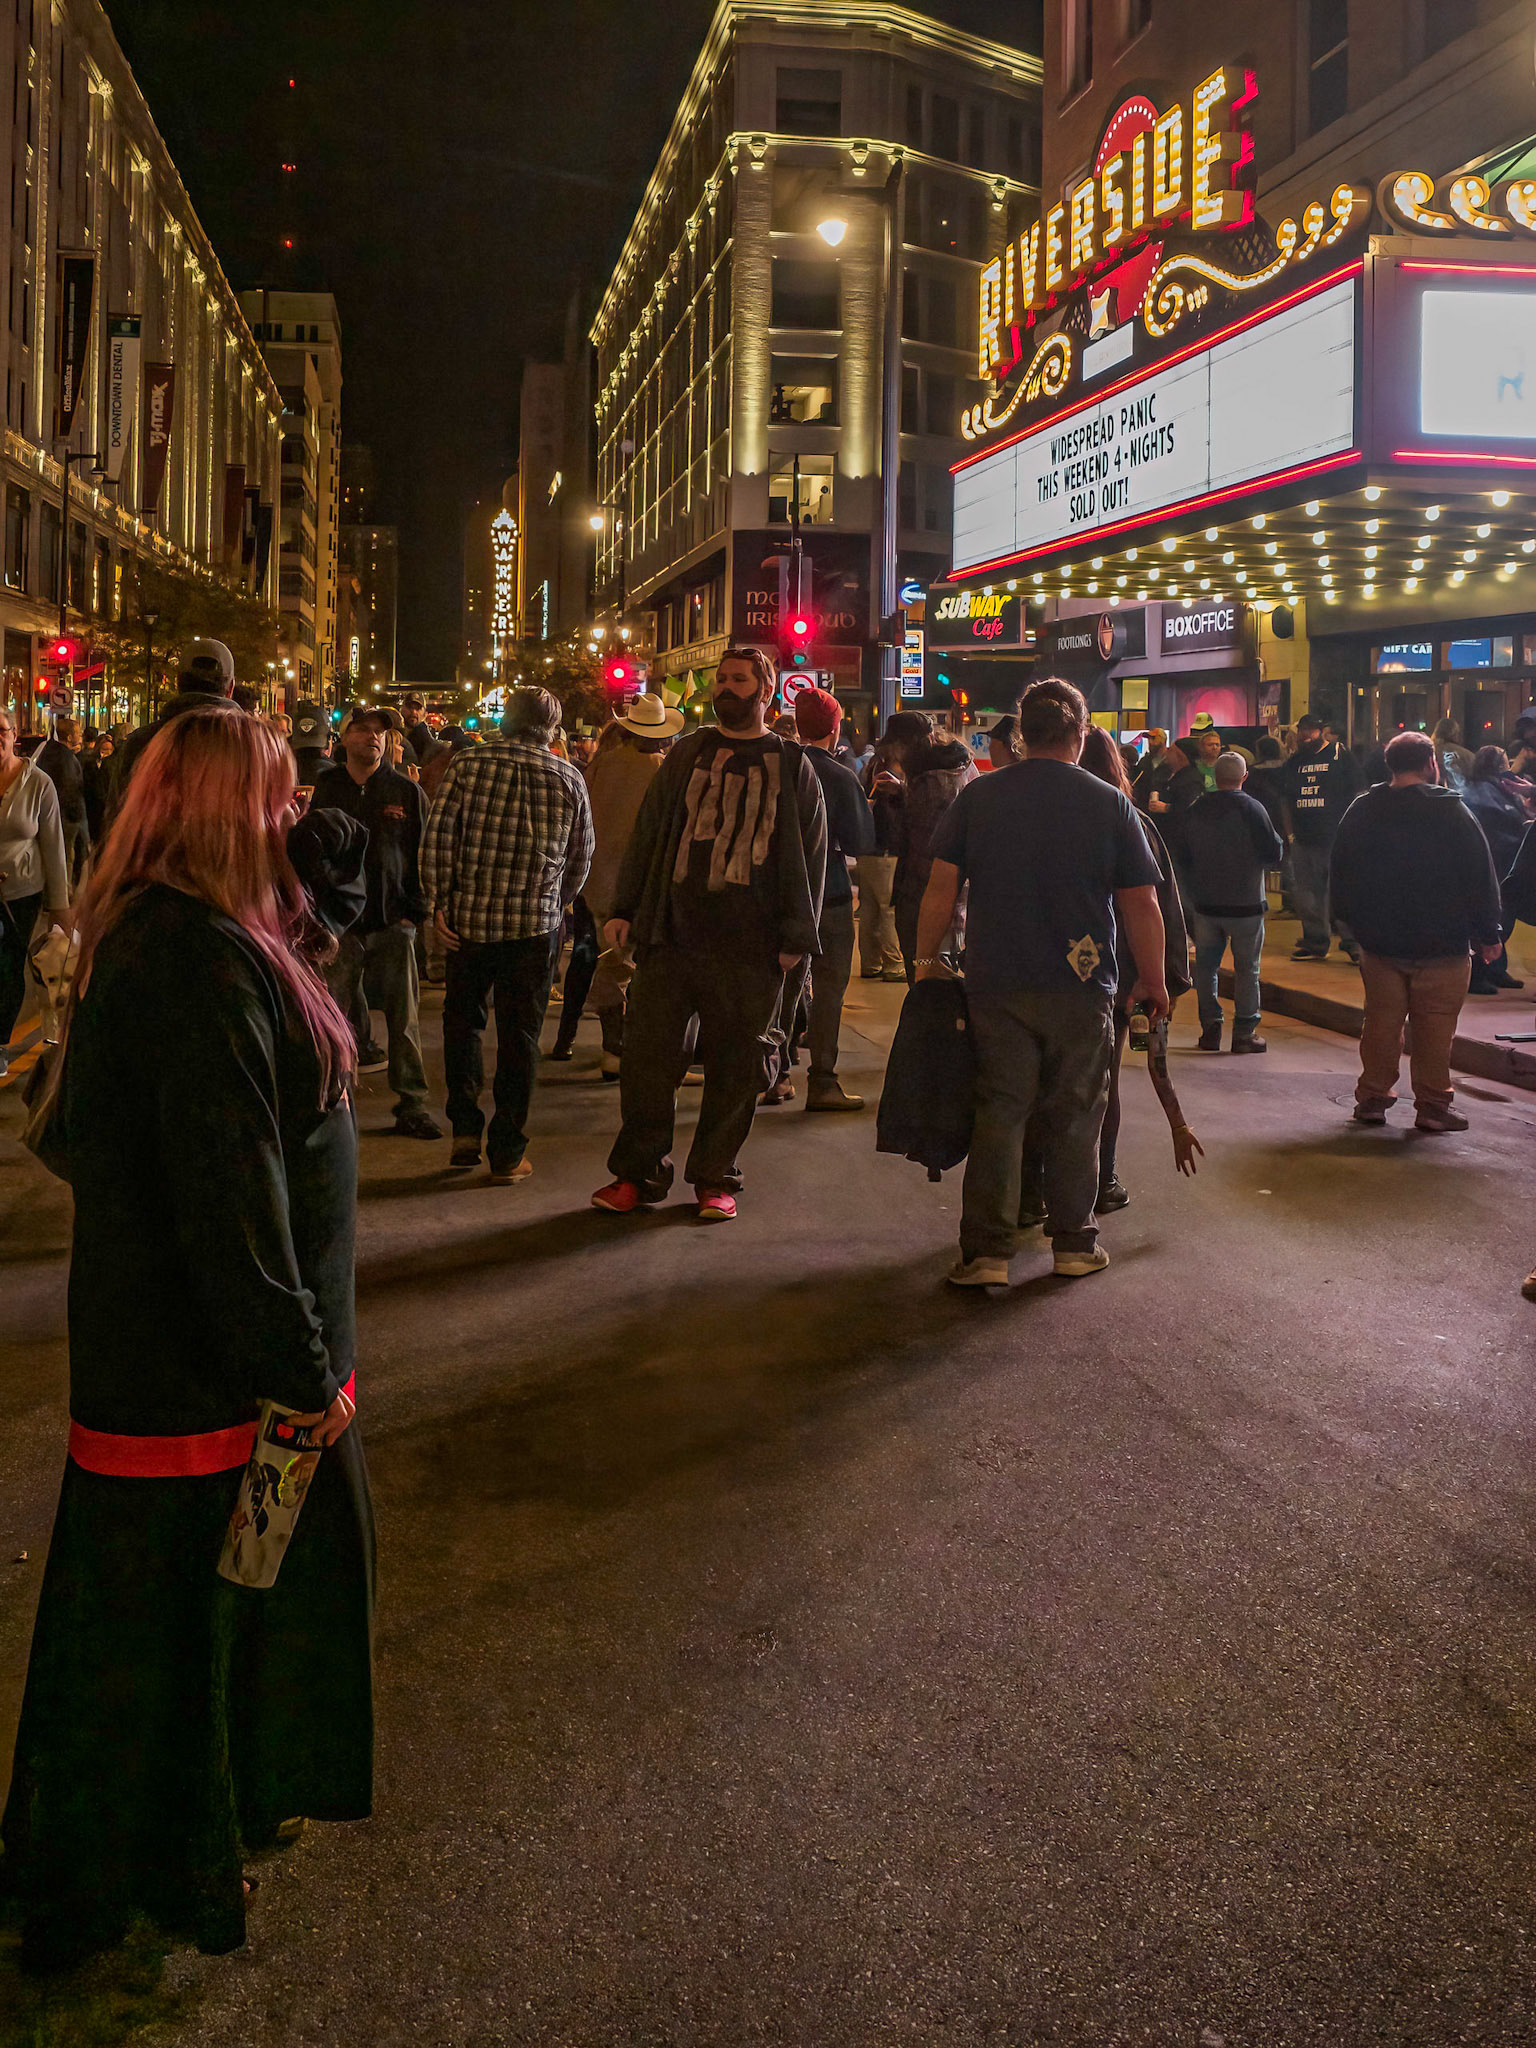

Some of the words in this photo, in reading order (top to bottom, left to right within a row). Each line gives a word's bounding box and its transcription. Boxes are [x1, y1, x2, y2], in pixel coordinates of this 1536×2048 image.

[979, 66, 1228, 380] RIVERSIDE
[113, 342, 124, 380] DENTAL
[111, 383, 123, 448] DOWNTOWN
[1051, 415, 1114, 466] WIDESPREAD
[1121, 393, 1156, 436] PANIC
[1037, 470, 1059, 502] THIS
[1063, 451, 1109, 493] WEEKEND
[1070, 489, 1096, 523] SOLD
[1102, 476, 1129, 512] OUT!
[497, 531, 511, 629] WARNER
[935, 595, 1012, 620] SUBWAY
[972, 618, 1004, 640] Cafe
[1057, 634, 1092, 651] FOOTLONGS
[1383, 644, 1409, 654] GIFT
[1302, 763, 1329, 773] CAME
[1297, 798, 1325, 808] DOWN
[1301, 786, 1320, 795] GET
